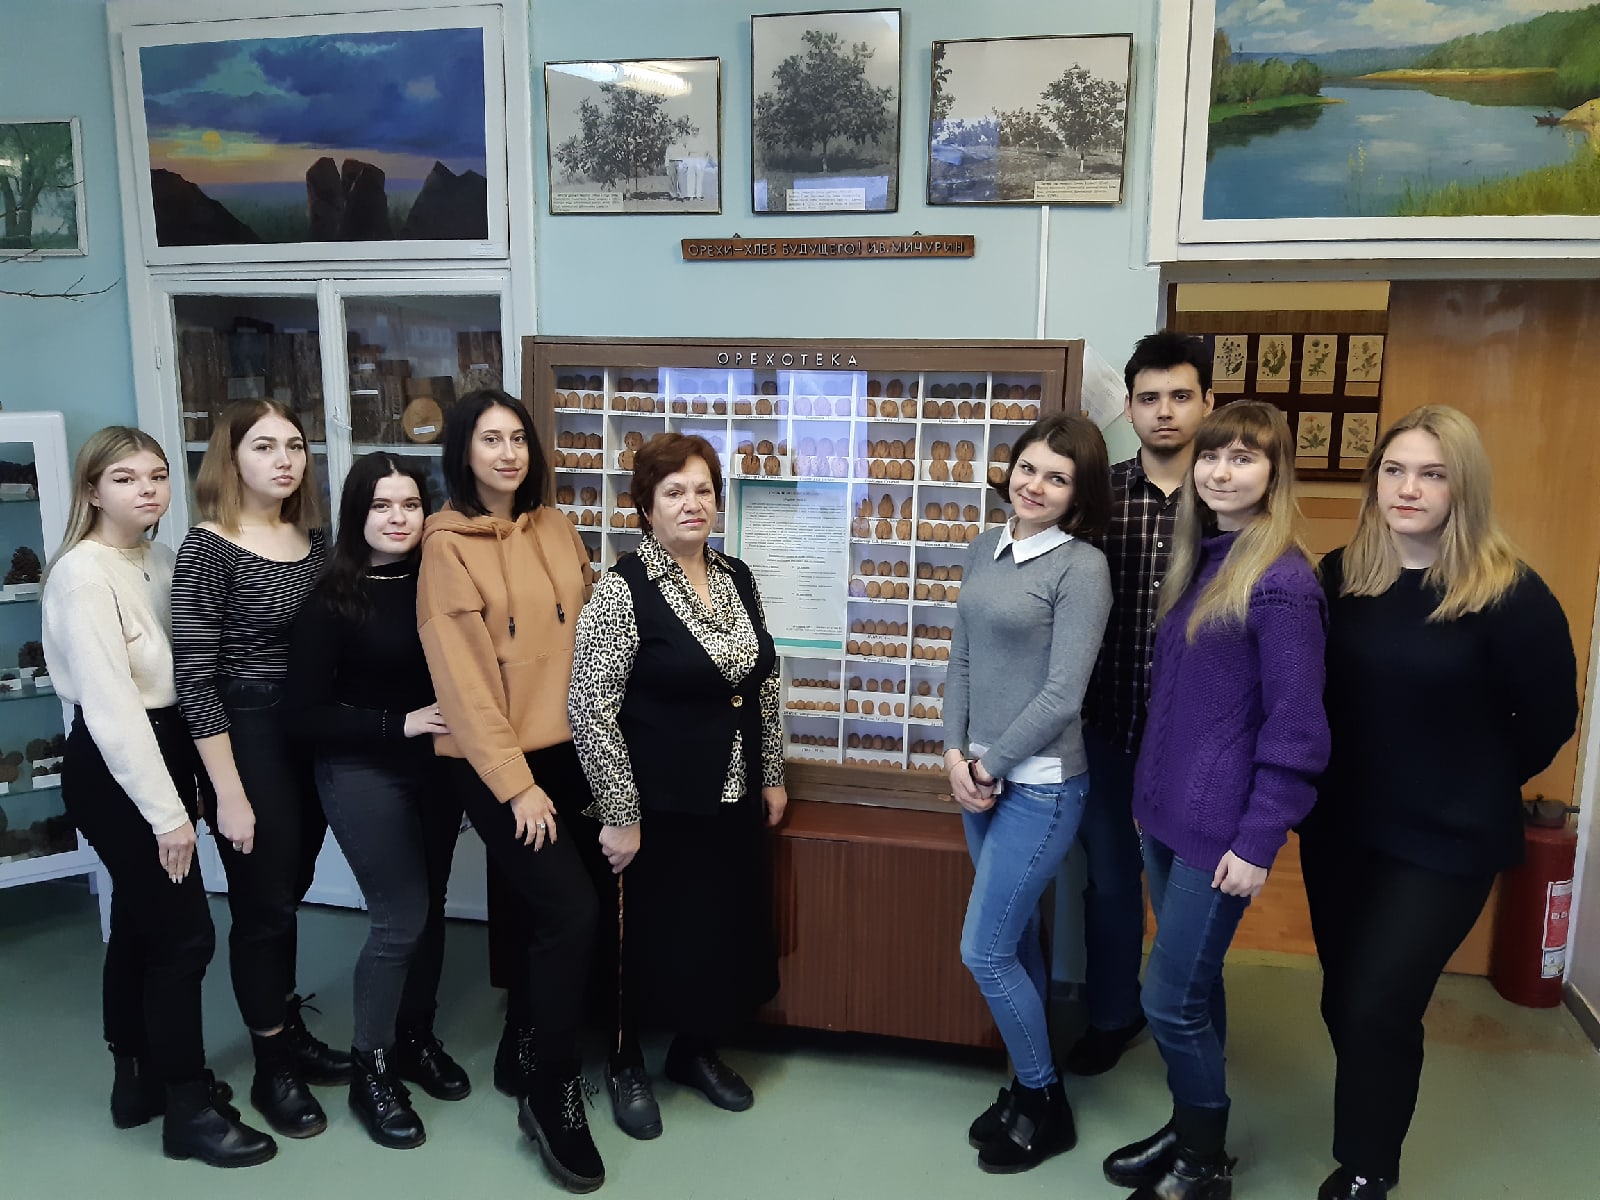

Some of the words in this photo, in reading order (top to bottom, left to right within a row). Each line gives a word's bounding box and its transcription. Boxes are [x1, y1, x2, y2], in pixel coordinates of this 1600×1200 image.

[782, 240, 862, 256] БУДУЩЕГО!
[892, 241, 965, 254] МИЧУРИН
[717, 352, 858, 367] ОРЕХОТЕКА
